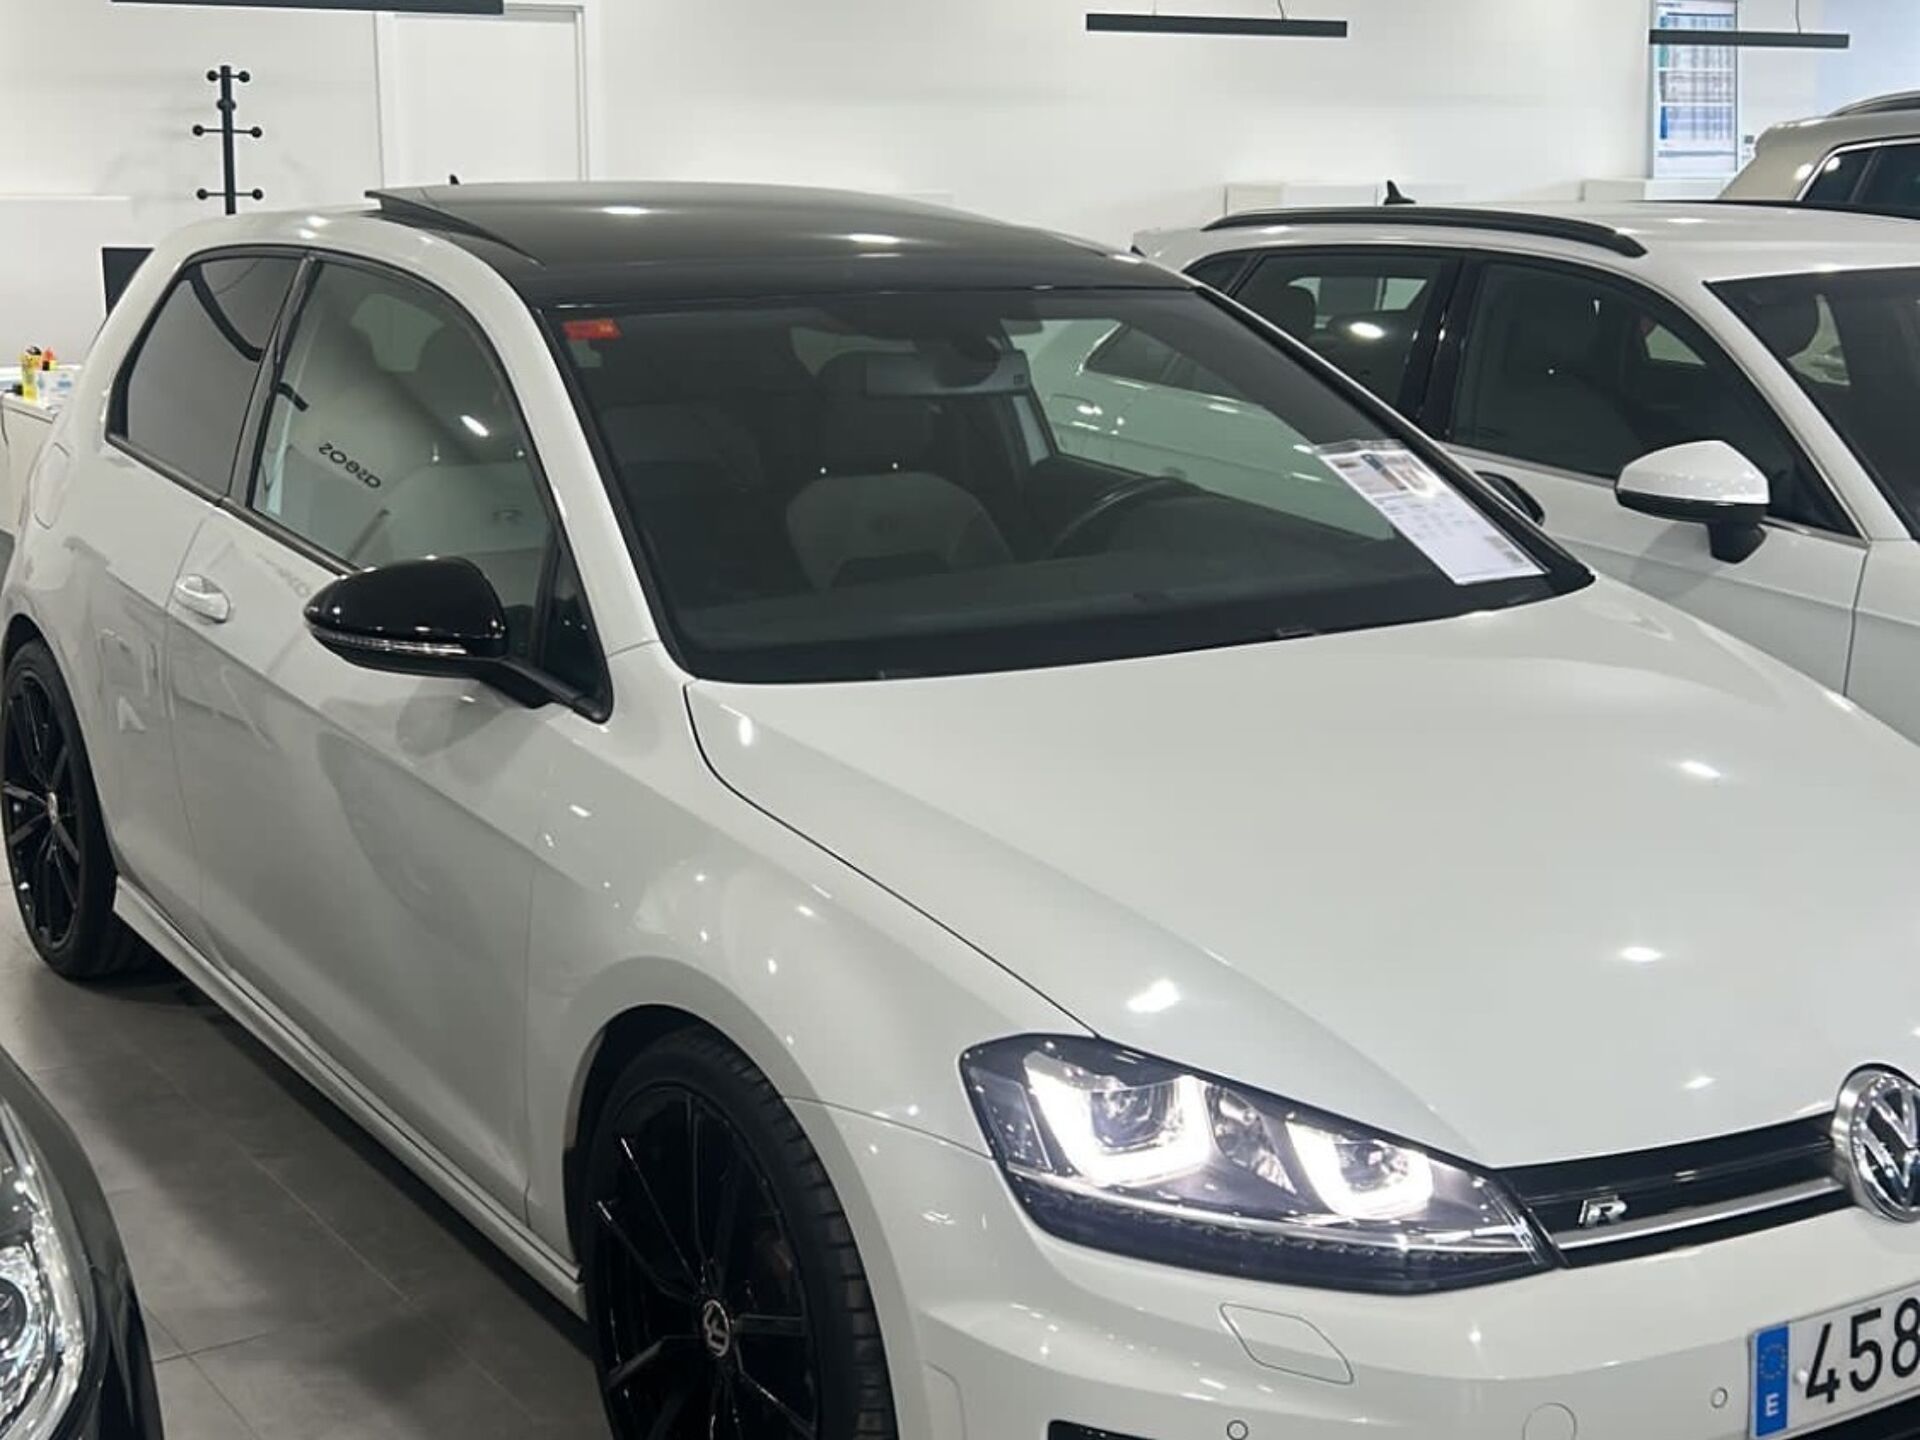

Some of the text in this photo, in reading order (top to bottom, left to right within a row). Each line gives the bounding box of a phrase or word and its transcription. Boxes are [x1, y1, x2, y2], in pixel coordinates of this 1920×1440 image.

[1577, 1194, 1628, 1227] R
[1805, 1297, 1920, 1404] 458
[1765, 1392, 1780, 1417] E
